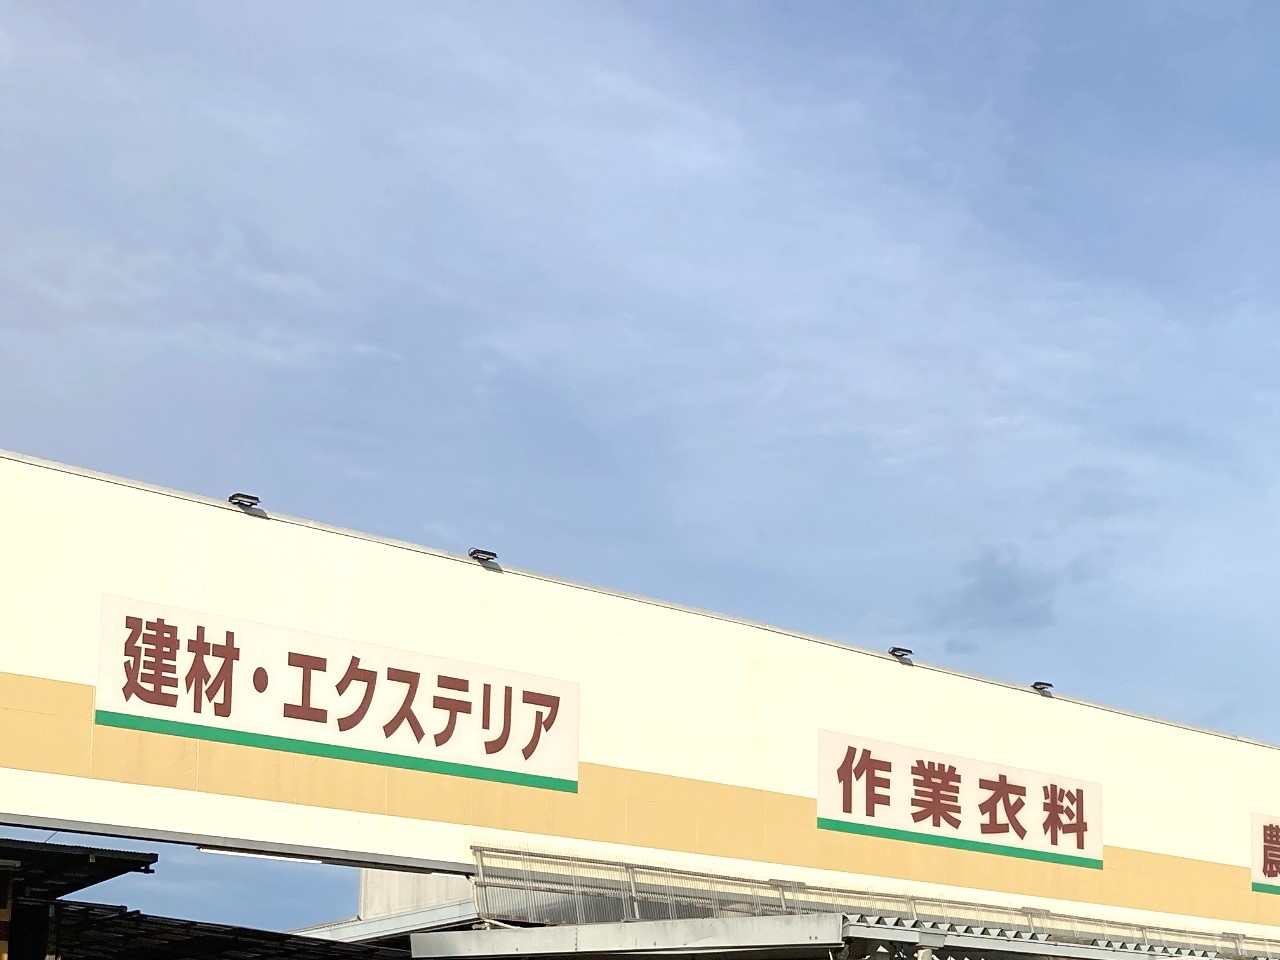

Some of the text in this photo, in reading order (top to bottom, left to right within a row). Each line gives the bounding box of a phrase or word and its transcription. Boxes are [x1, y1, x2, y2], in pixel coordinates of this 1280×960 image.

[122, 615, 561, 761] 建材・エクステリア
[836, 745, 1088, 850] 作業衣料
